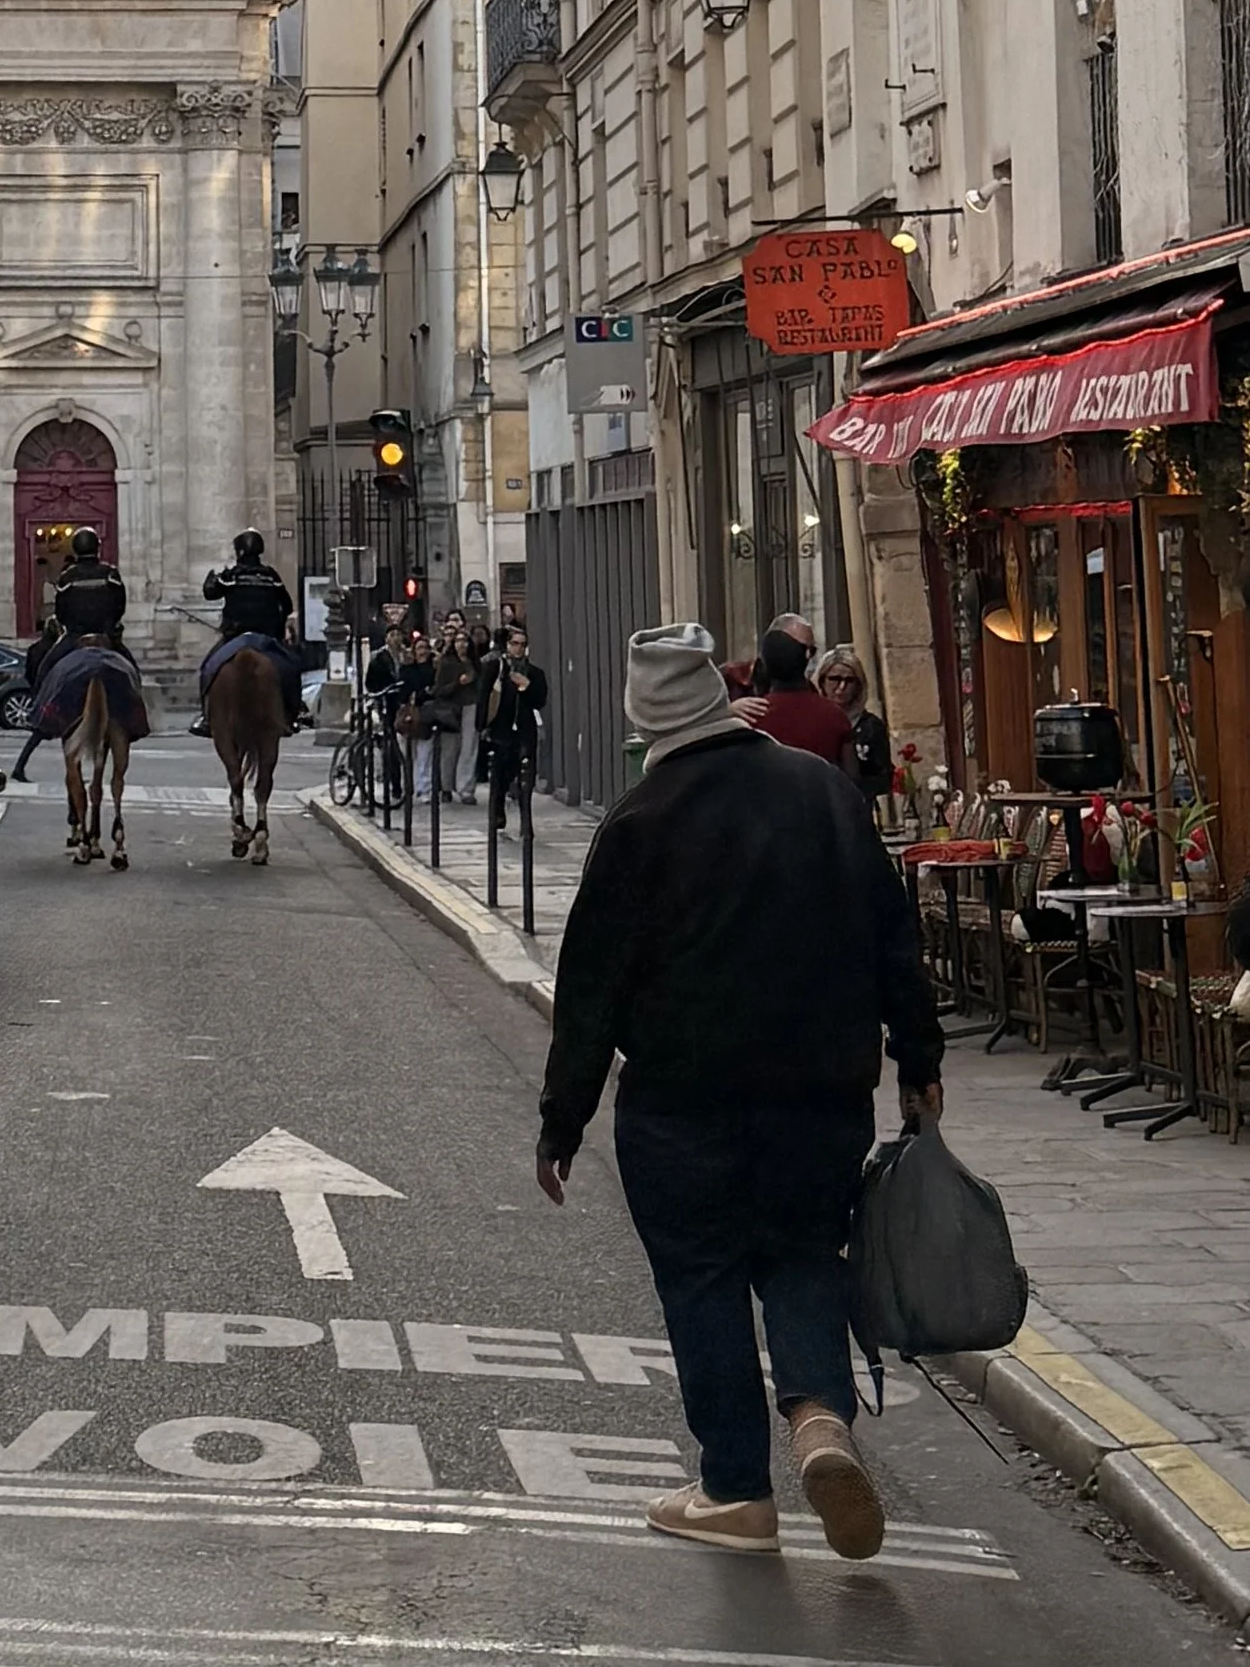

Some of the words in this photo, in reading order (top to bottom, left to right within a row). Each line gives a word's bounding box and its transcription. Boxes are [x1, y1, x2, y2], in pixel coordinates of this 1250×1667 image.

[785, 236, 859, 259] CASA
[752, 263, 804, 285] SAN
[828, 304, 884, 325] TAPAS
[581, 319, 630, 339] CIC
[777, 323, 884, 346] RESTAURANT
[829, 416, 887, 455] BAR
